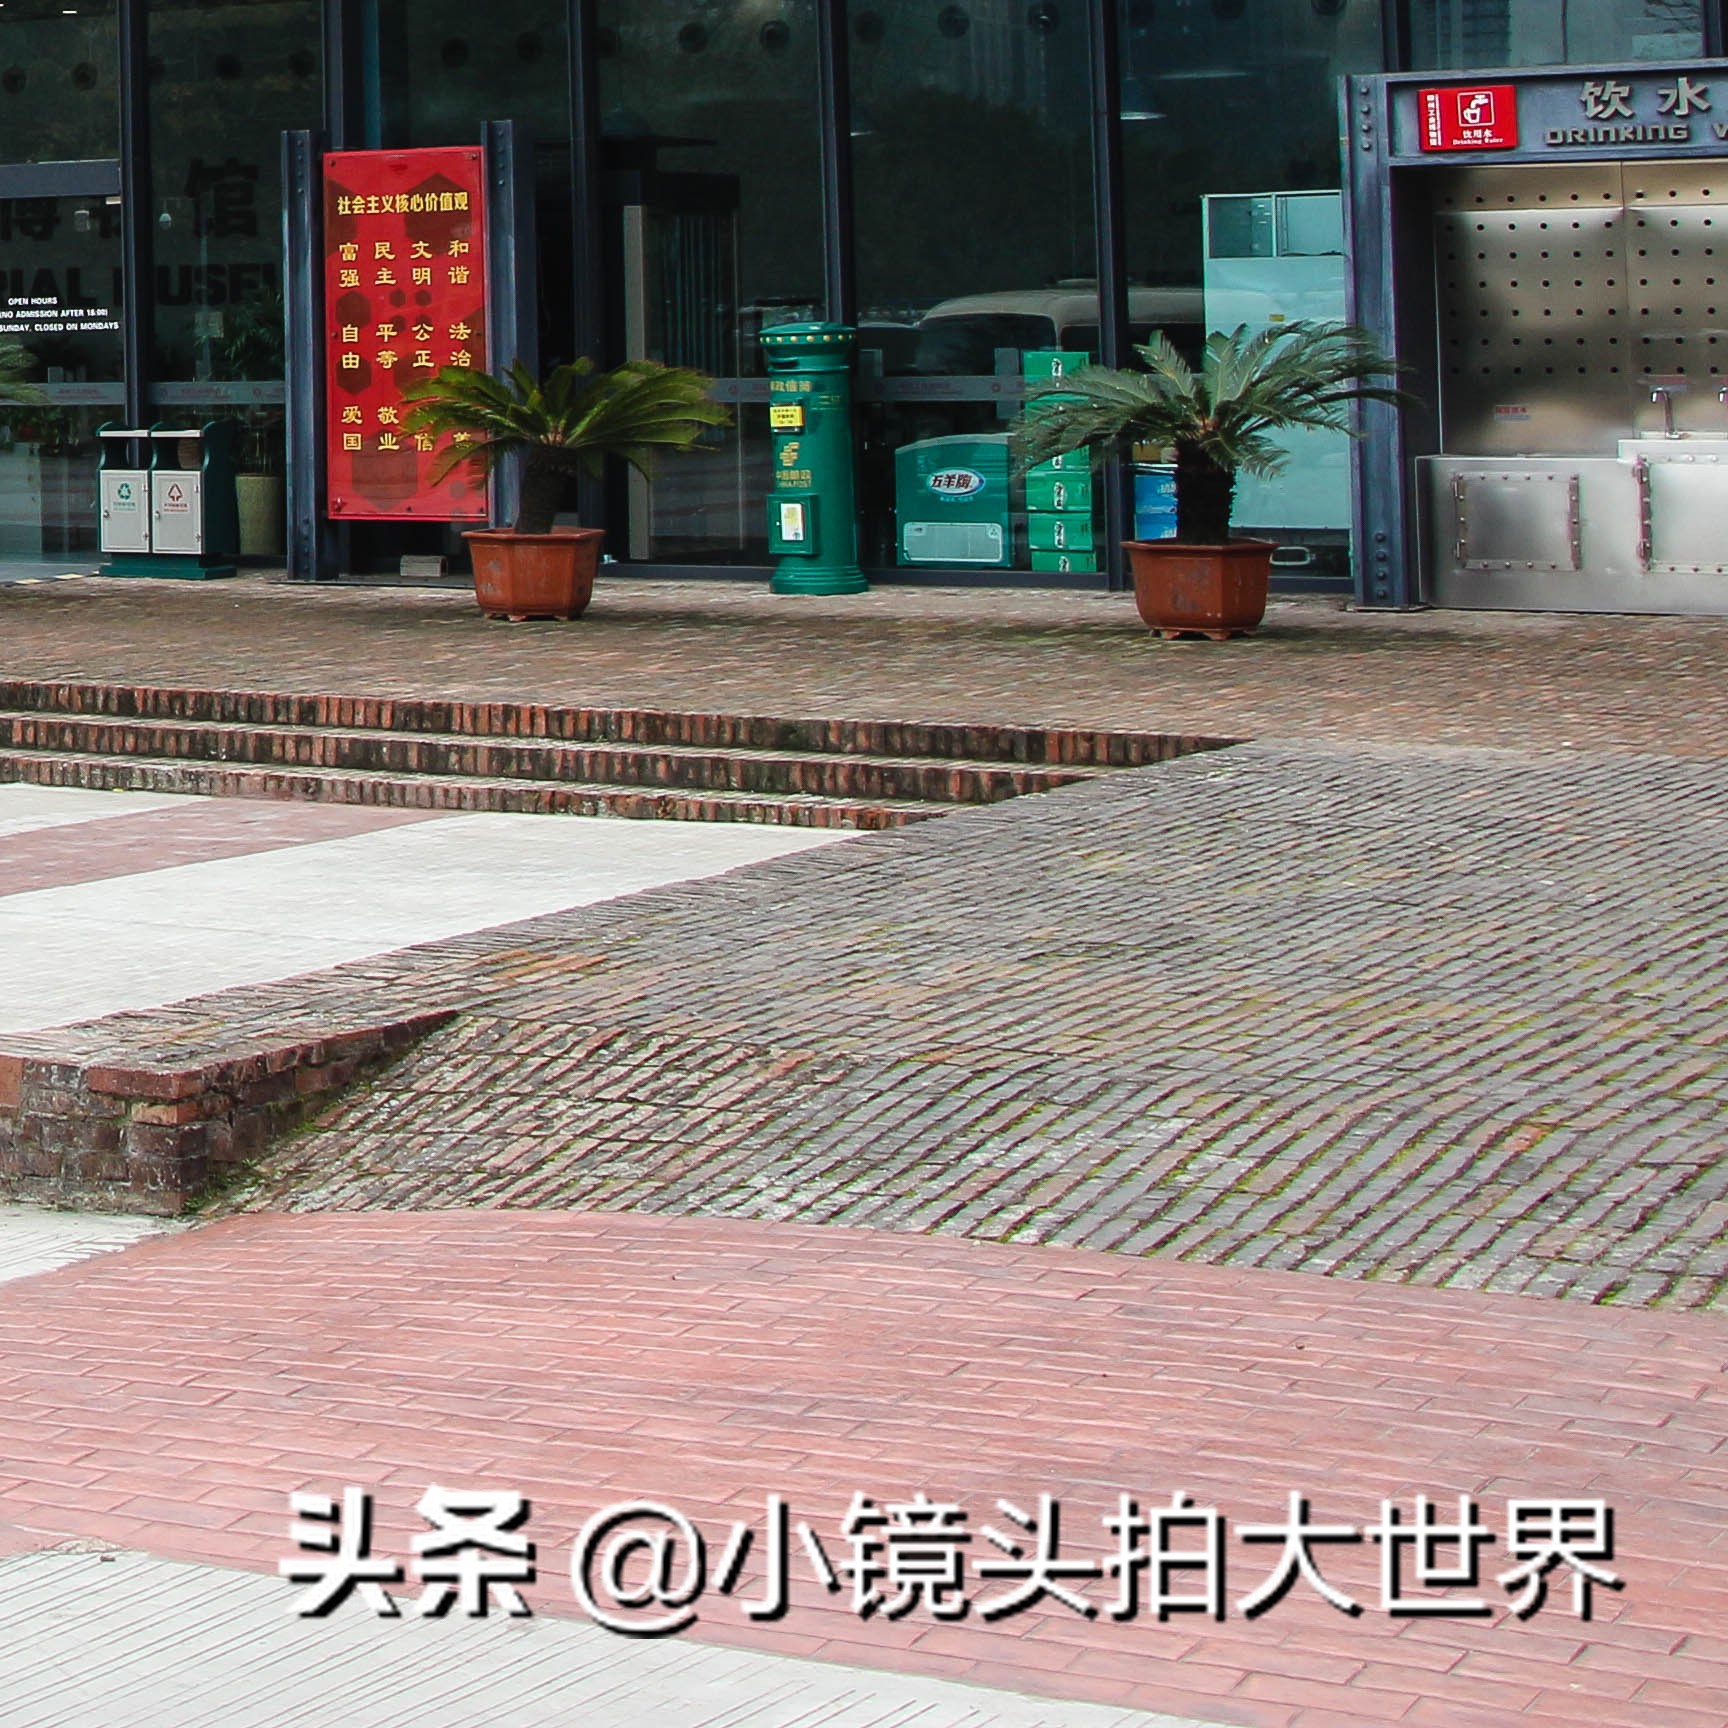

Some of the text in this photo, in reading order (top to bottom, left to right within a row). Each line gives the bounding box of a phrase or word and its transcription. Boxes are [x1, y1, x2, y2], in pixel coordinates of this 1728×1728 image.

[1580, 76, 1712, 120] 饮水
[1463, 129, 1493, 139] 饮用水
[1544, 124, 1690, 145] DRINKING
[337, 192, 469, 215] 社会主义核心价值观
[8, 296, 58, 306] OPEN HOURS
[16, 309, 59, 318] ADMISSION
[60, 308, 85, 317] AFTER
[34, 323, 64, 332] CLOSED
[66, 322, 79, 331] ON
[80, 321, 120, 330] MONDAYS
[931, 474, 973, 489] 五羊牌
